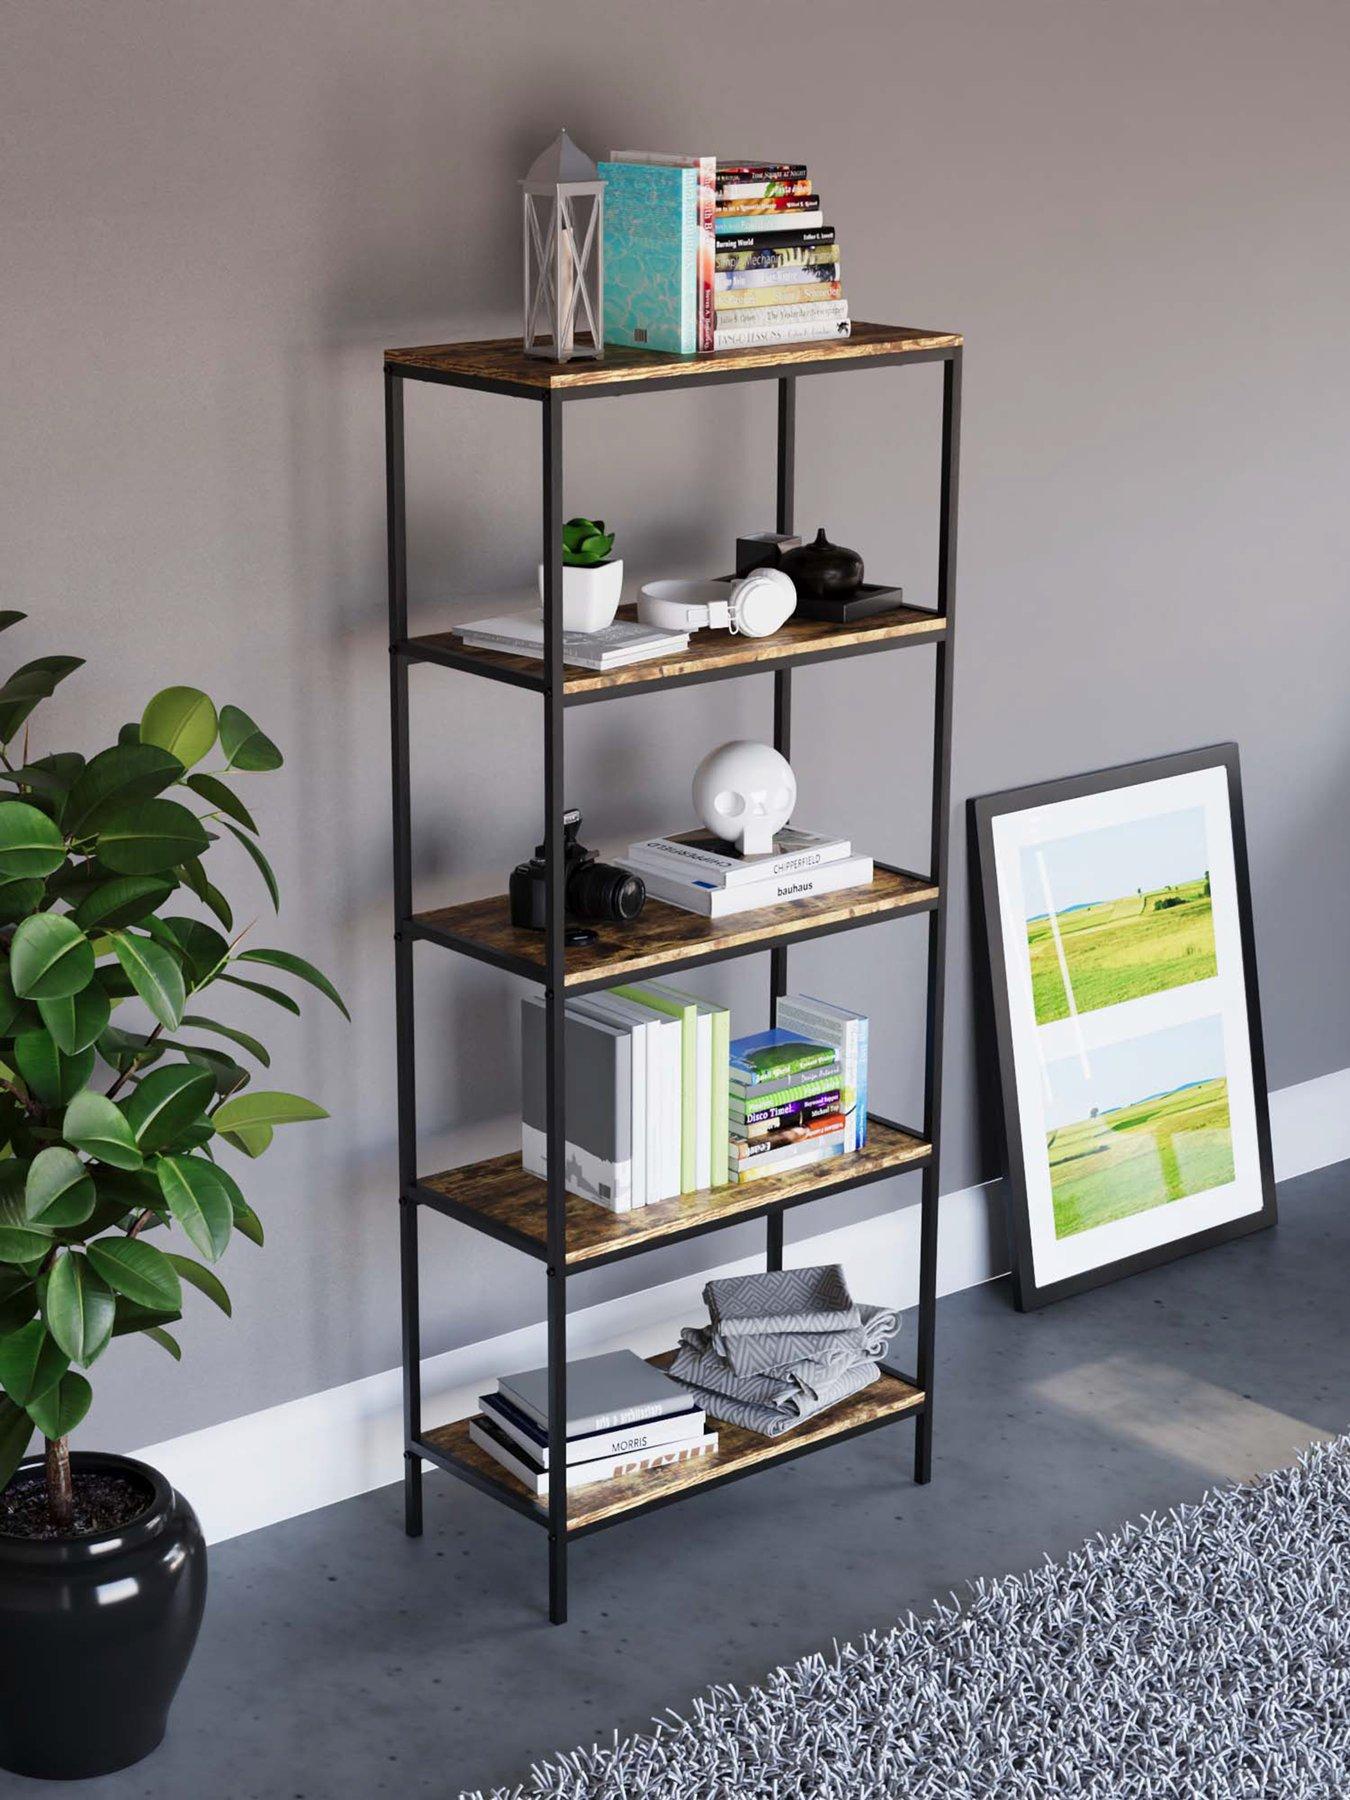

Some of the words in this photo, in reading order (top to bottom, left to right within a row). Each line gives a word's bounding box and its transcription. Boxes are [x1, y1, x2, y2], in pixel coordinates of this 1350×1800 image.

[738, 238, 754, 247] World
[774, 854, 821, 874] CHIPPERFIELD
[777, 882, 813, 897] bauhaus
[746, 1109, 769, 1124] Disco
[769, 1103, 793, 1117] Time!
[611, 1436, 648, 1453] MORRIS
